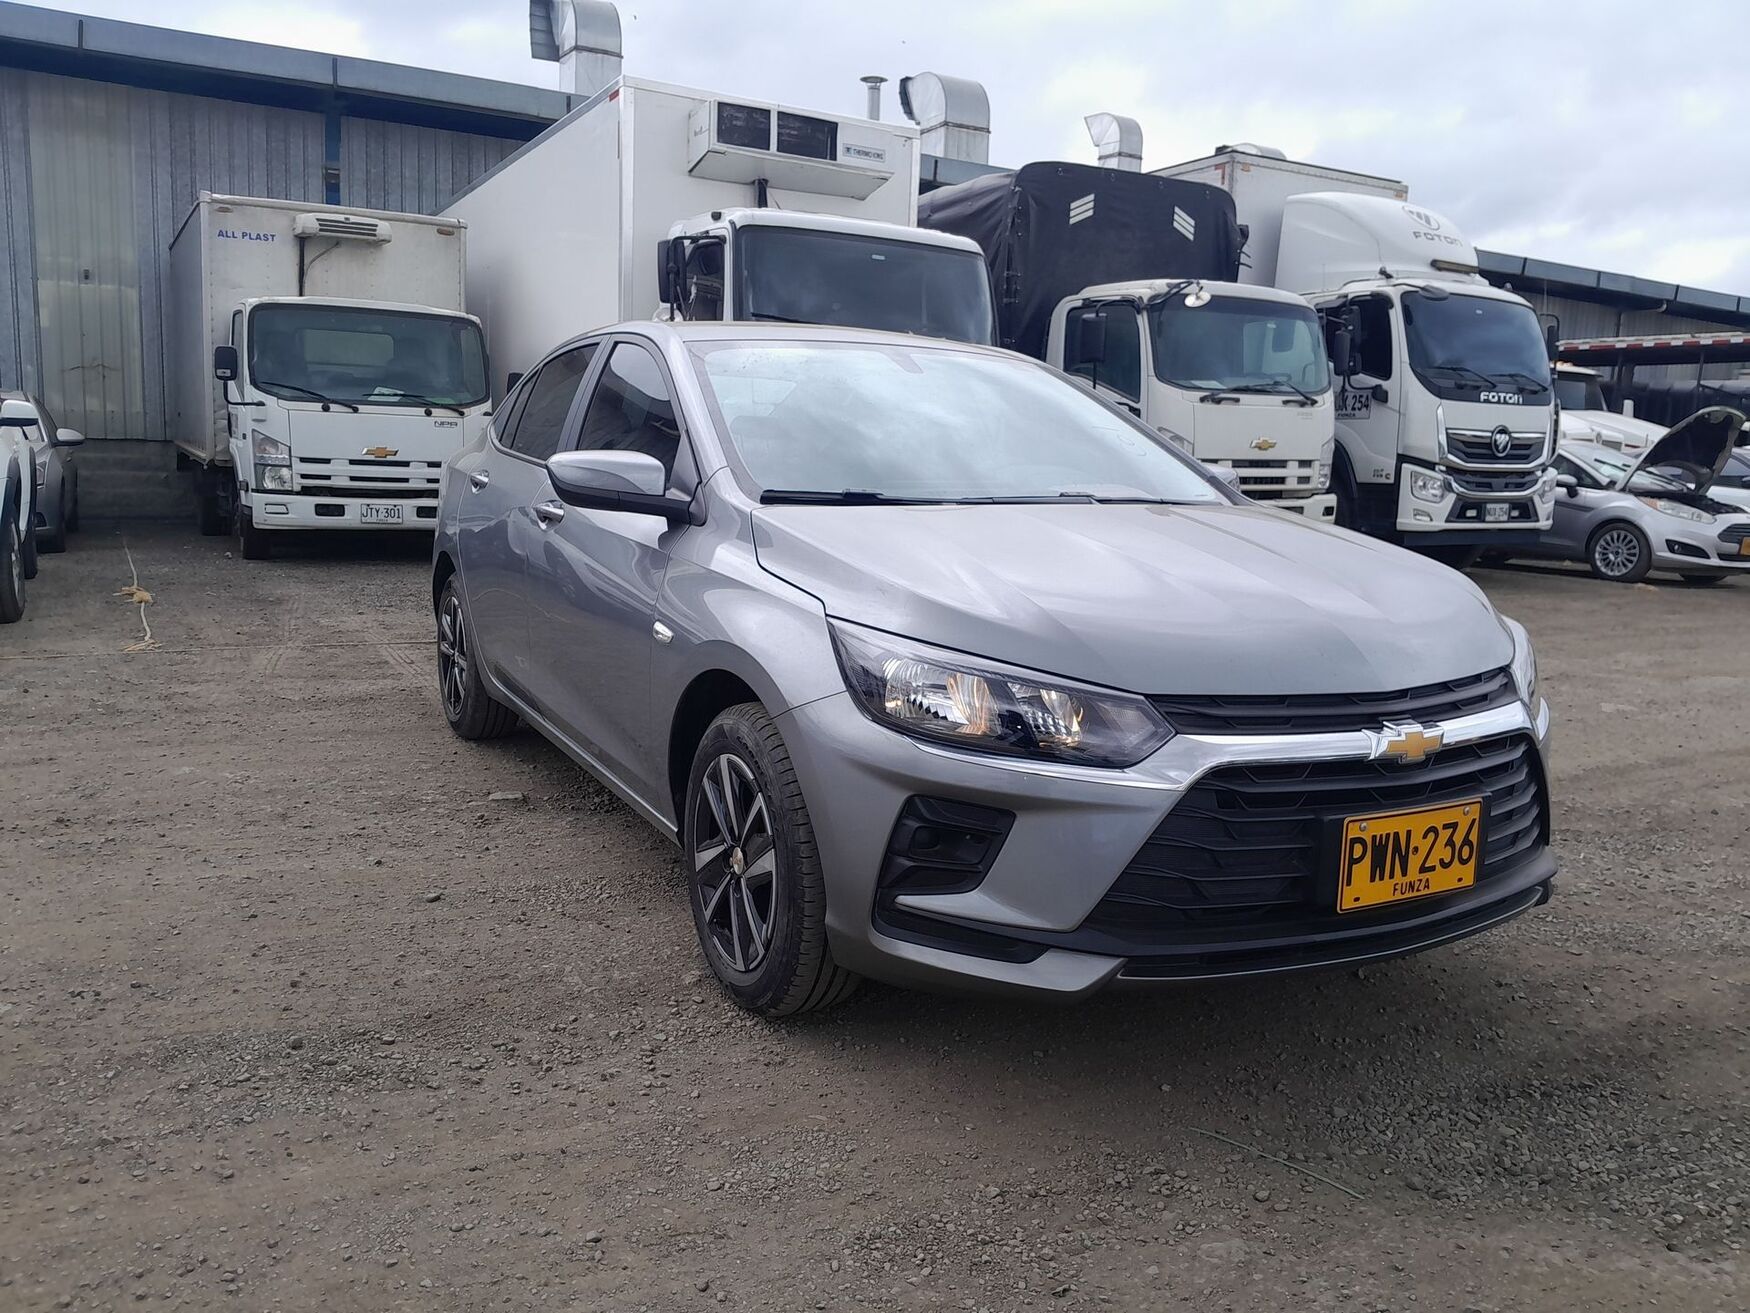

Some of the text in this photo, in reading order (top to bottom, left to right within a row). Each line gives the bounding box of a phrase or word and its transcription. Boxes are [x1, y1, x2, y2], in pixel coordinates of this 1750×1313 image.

[217, 229, 276, 242] ALL PLAST
[1392, 877, 1430, 896] FUNZA
